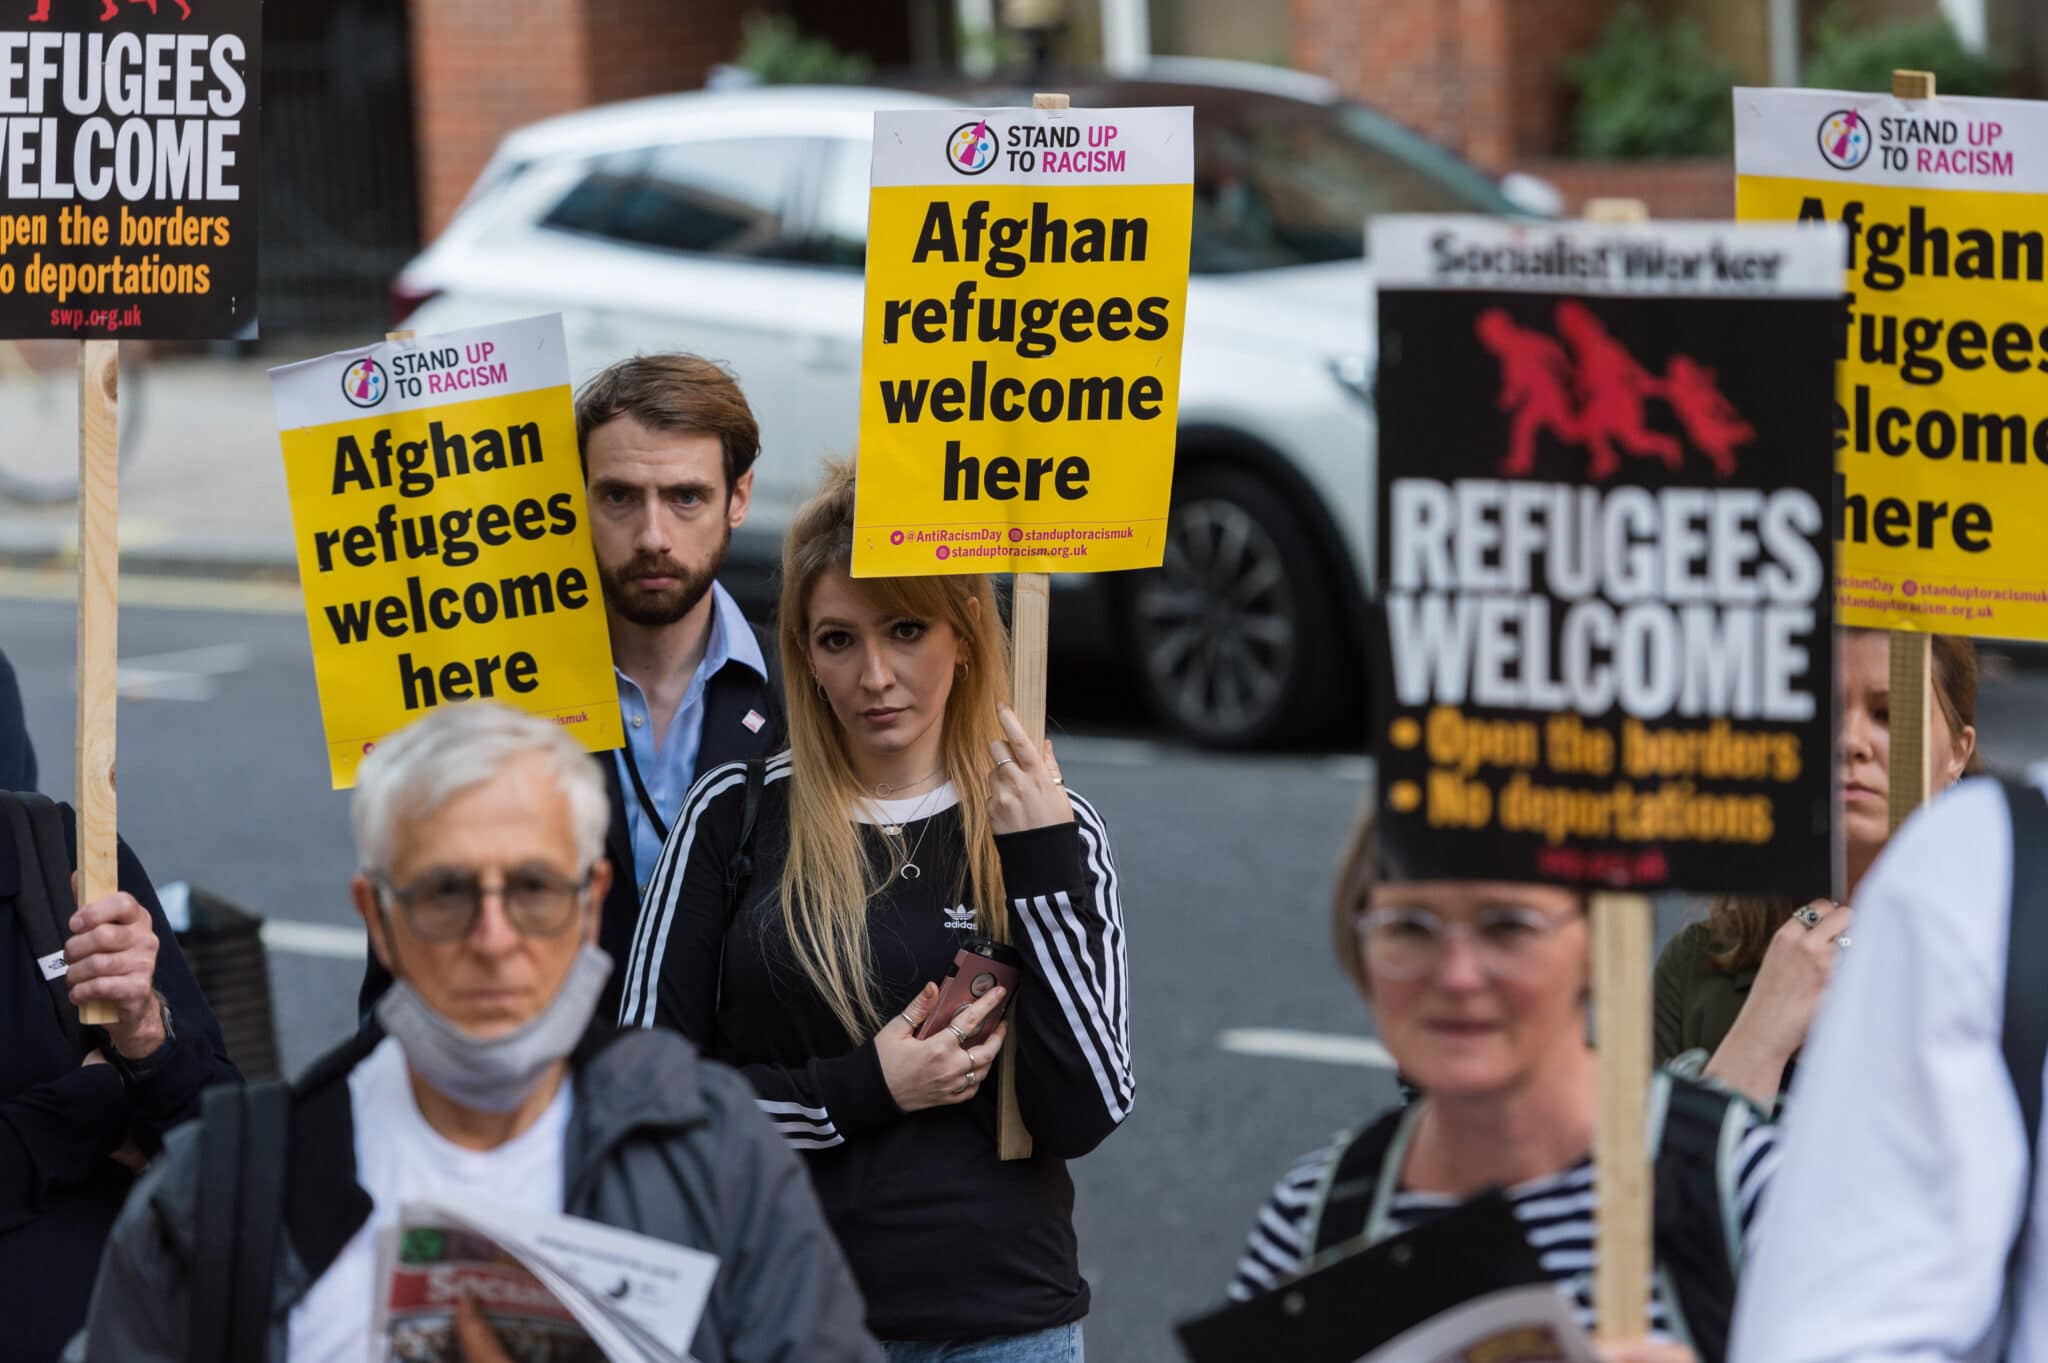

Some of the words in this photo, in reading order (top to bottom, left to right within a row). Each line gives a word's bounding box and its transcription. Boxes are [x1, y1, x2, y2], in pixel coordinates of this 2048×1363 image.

[0, 32, 246, 117] EFUGEES
[0, 117, 240, 201] ELCOME
[1007, 126, 1080, 148] STAND
[1088, 126, 1118, 147] UP
[1007, 151, 1035, 172] TO
[1042, 151, 1126, 173] RACISM
[1880, 117, 1958, 145] STAND
[1968, 121, 2003, 147] UP
[1880, 146, 1908, 171] TO
[1917, 149, 2014, 177] RACISM
[0, 214, 47, 254] pen
[59, 205, 109, 246] the
[120, 205, 230, 247] borders
[912, 200, 1148, 278] Afghan
[0, 264, 15, 294] o
[25, 253, 210, 302] deportations
[51, 305, 142, 330] swp.org.uk
[883, 281, 1169, 358] refugees
[1833, 293, 2048, 386] fugee
[392, 347, 459, 376] STAND
[465, 341, 495, 364] UP
[395, 377, 422, 399] TO
[428, 362, 508, 394] RACISM
[880, 360, 1164, 424] welcome
[332, 421, 543, 497] Afghan
[943, 440, 1090, 502] here
[314, 492, 577, 573] refugees
[951, 545, 1088, 559] standuptoracism.org.uk
[1025, 527, 1134, 543] standuptoracismuk
[1392, 480, 1822, 603] REFUGEES
[324, 567, 589, 645] welcome
[398, 649, 539, 711] here
[1388, 595, 1816, 720] WELCOME
[1426, 706, 1539, 774] Open
[1545, 715, 1615, 775] the
[1622, 719, 1801, 782] borders
[1427, 768, 1491, 828] No
[1499, 774, 1774, 844] deportations
